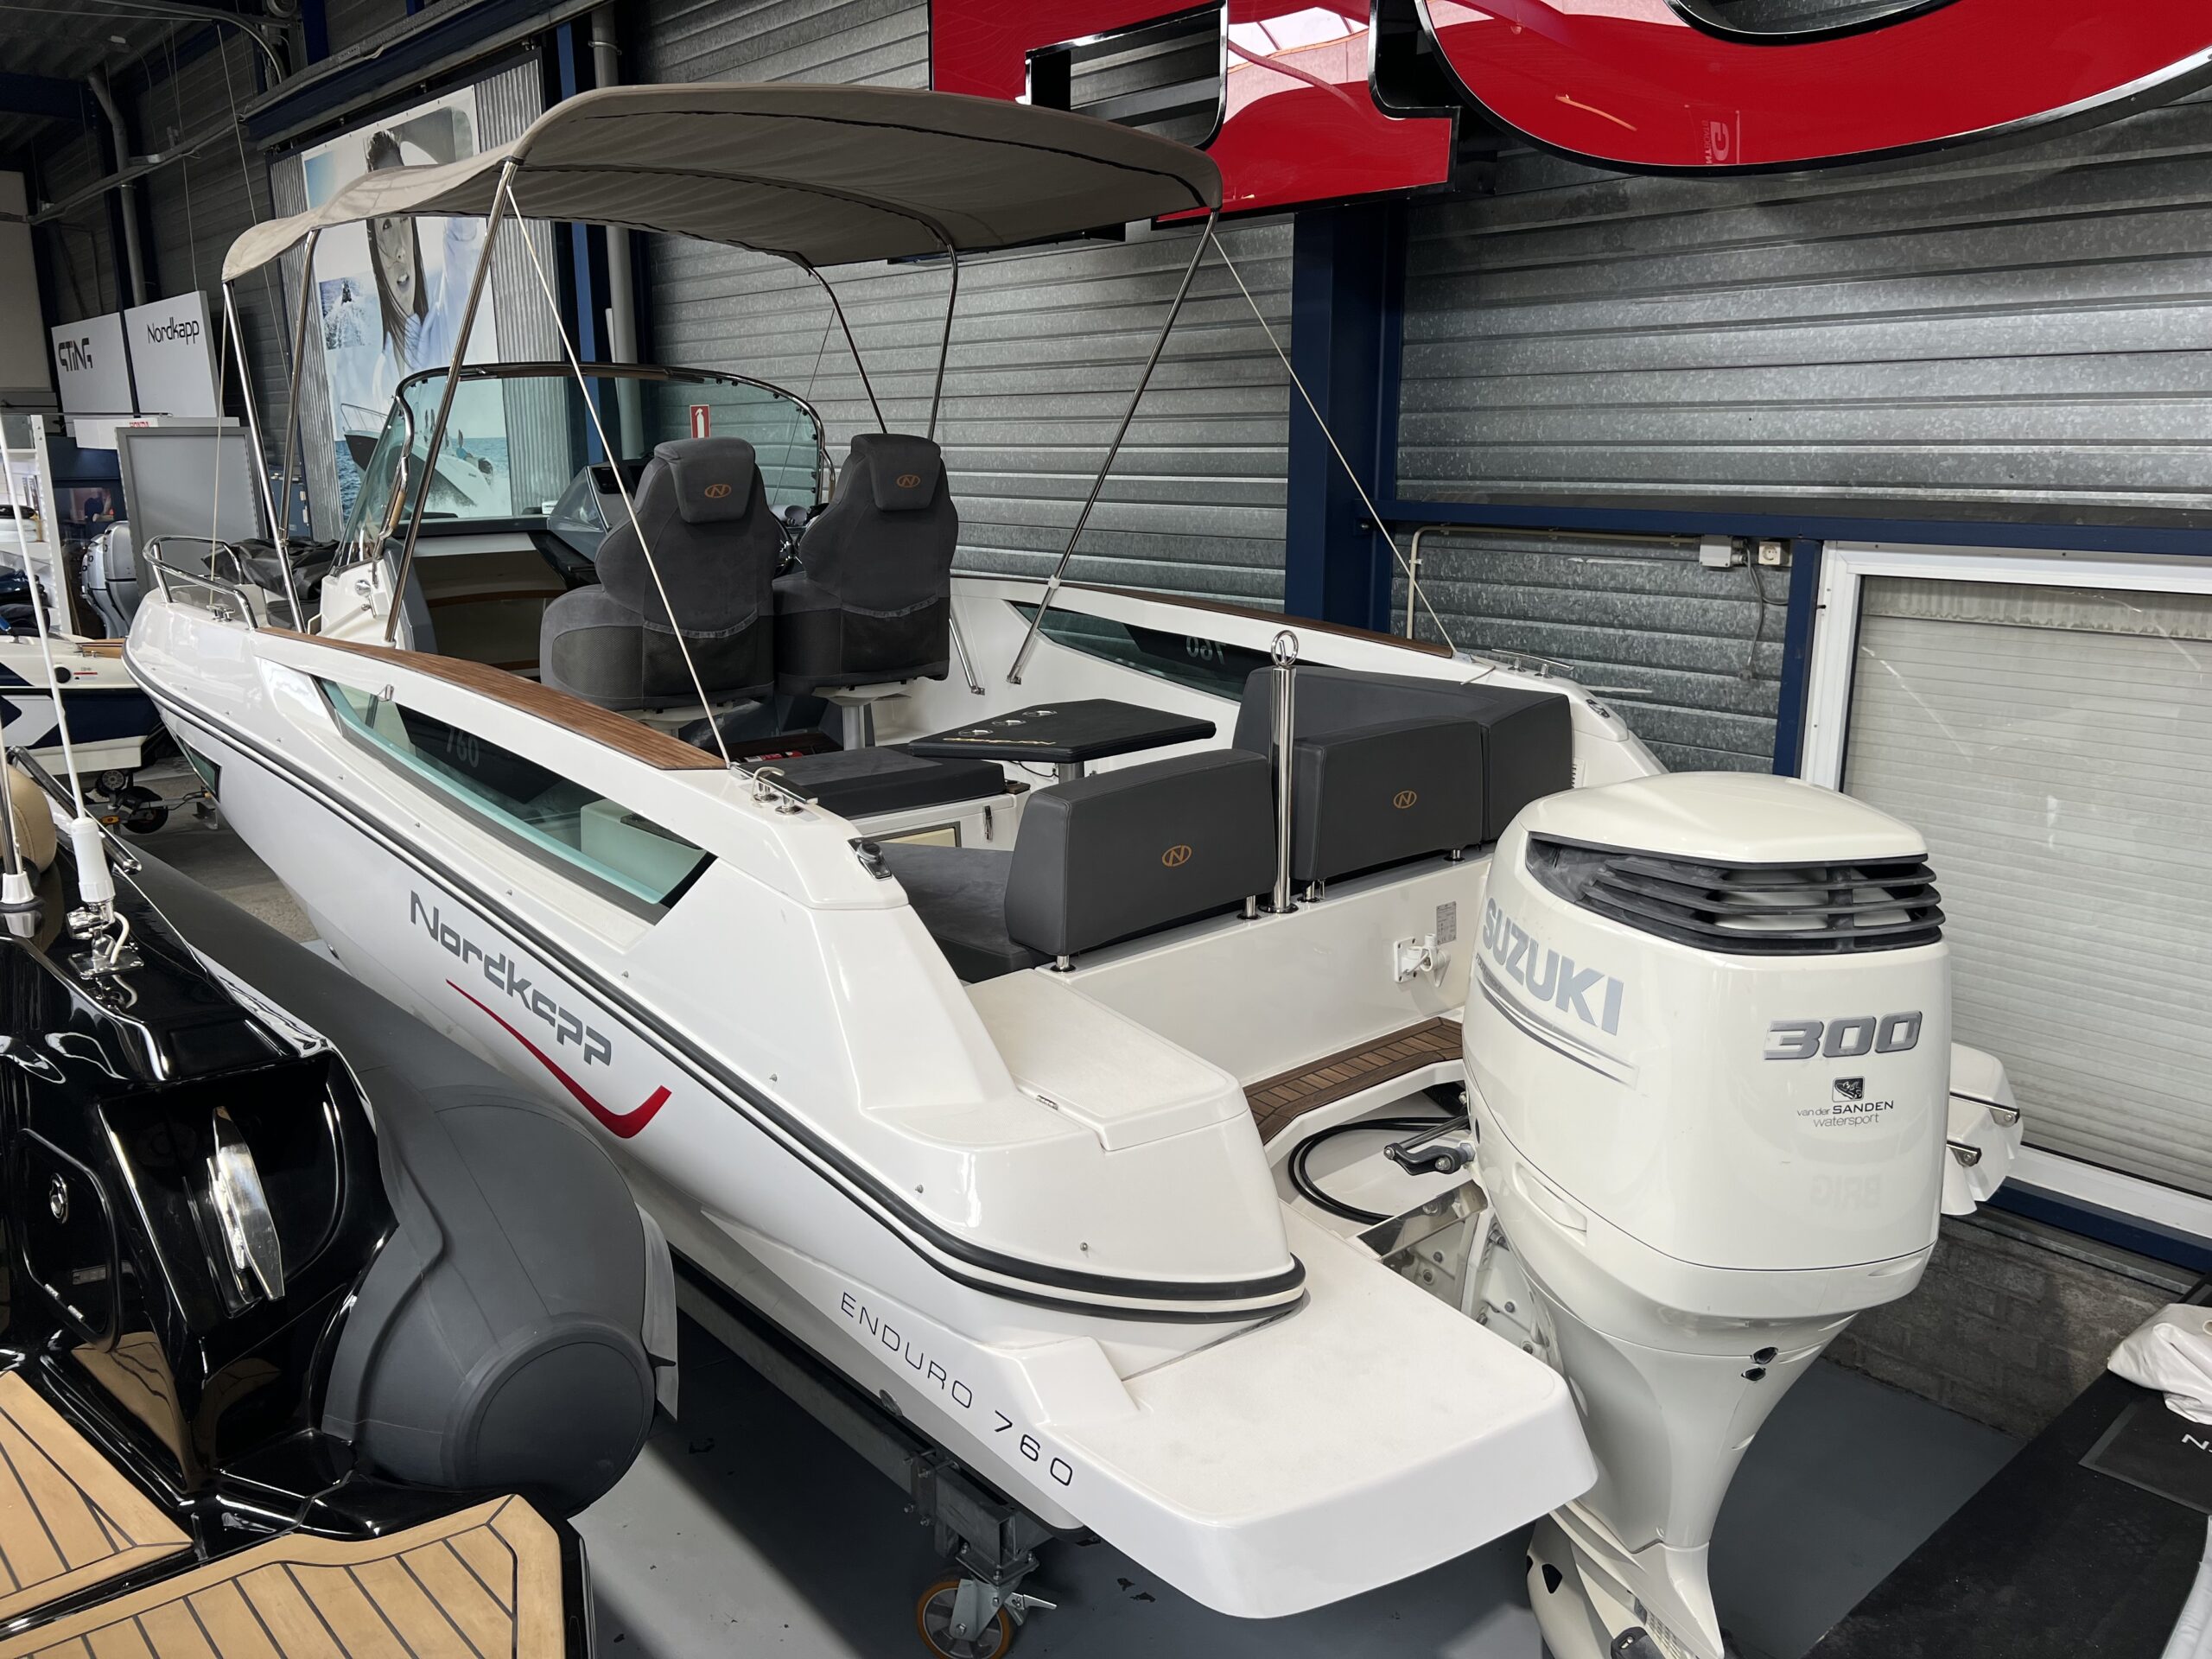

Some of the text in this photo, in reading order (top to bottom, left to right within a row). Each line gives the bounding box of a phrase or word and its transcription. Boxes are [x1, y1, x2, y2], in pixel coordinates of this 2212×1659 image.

[147, 317, 200, 345] Nordkapp
[410, 890, 612, 1066] Nordkapp
[1483, 897, 1624, 1036] SUZUKI
[1764, 1010, 1923, 1060] 300
[1814, 1113, 1879, 1127] watersport
[1833, 1100, 1894, 1115] SANDEN
[841, 1292, 1072, 1486] ENDURO 760
